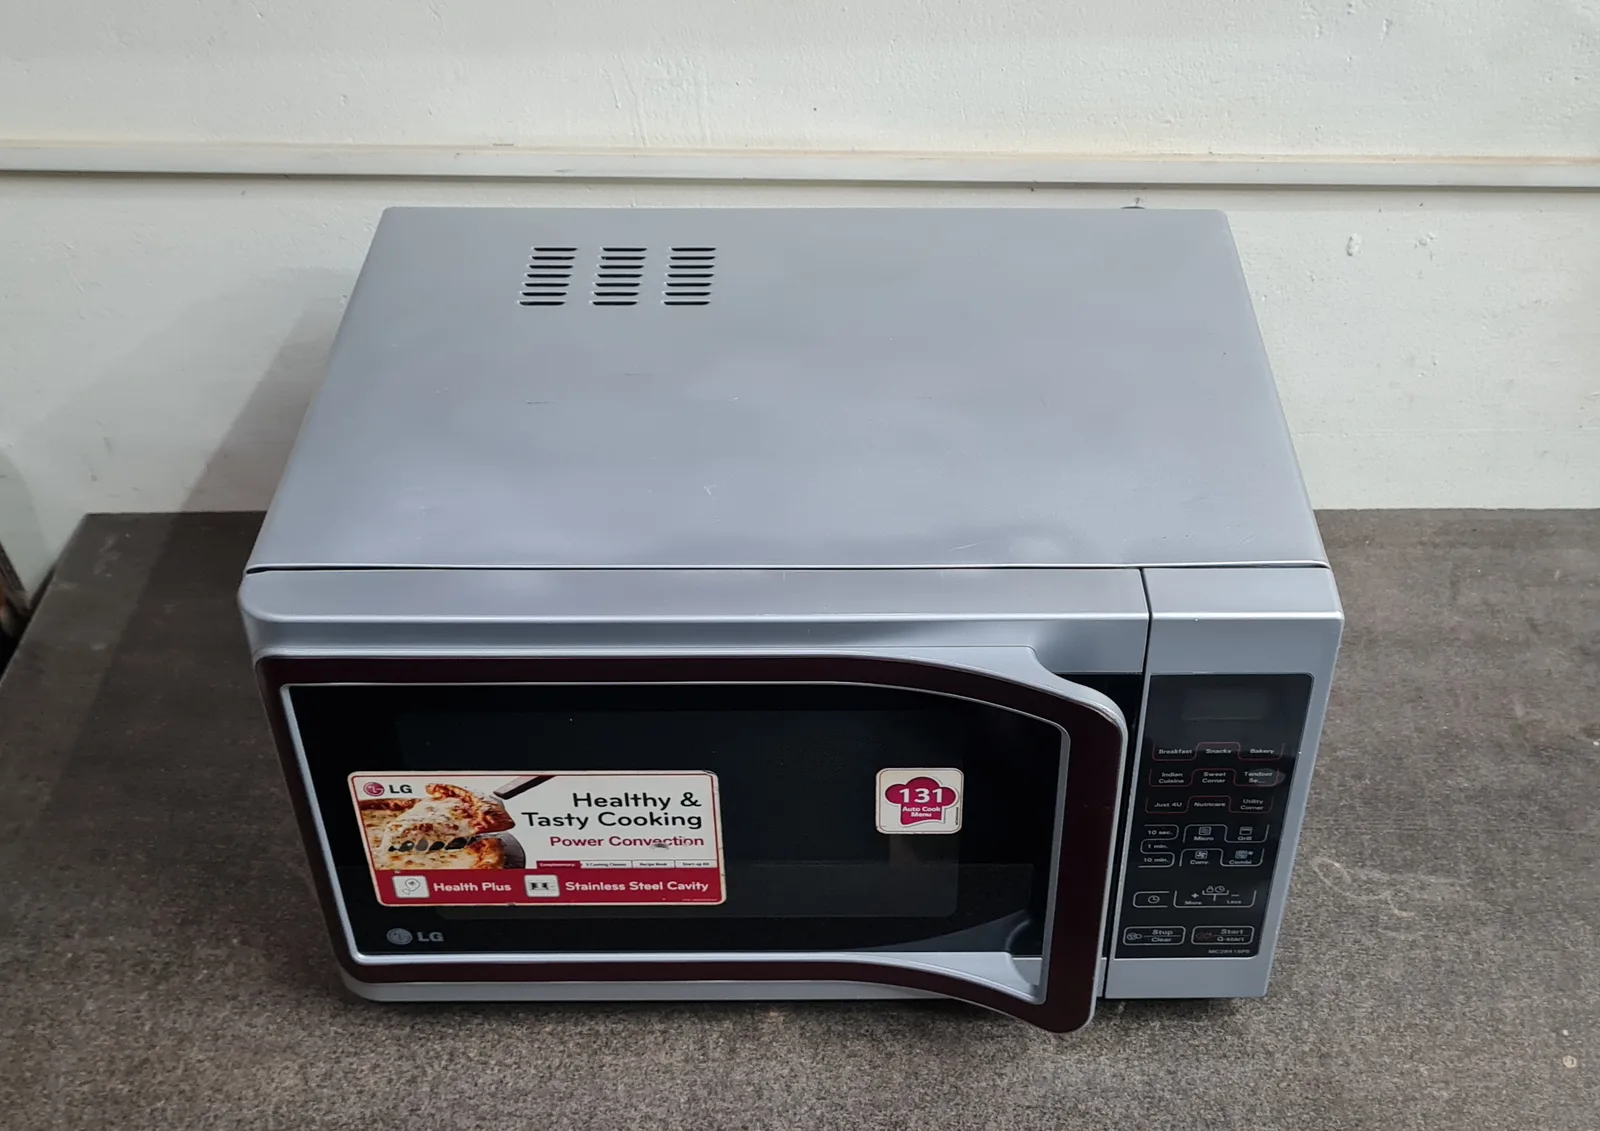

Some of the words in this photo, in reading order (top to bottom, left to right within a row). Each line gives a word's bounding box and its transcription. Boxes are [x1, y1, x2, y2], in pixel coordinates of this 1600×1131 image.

[389, 785, 412, 793] LG
[573, 792, 671, 810] Healthy
[680, 792, 702, 808] &
[900, 788, 943, 803] 131
[522, 812, 589, 830] Tasty
[598, 812, 702, 829] Cooking
[550, 836, 603, 847] Power
[612, 836, 704, 848] Convection
[434, 881, 478, 892] Health
[482, 881, 512, 892] Plus
[565, 881, 626, 891] Stainless
[629, 881, 663, 891] Steel
[667, 881, 709, 892] Cavity
[417, 931, 444, 942] LG
